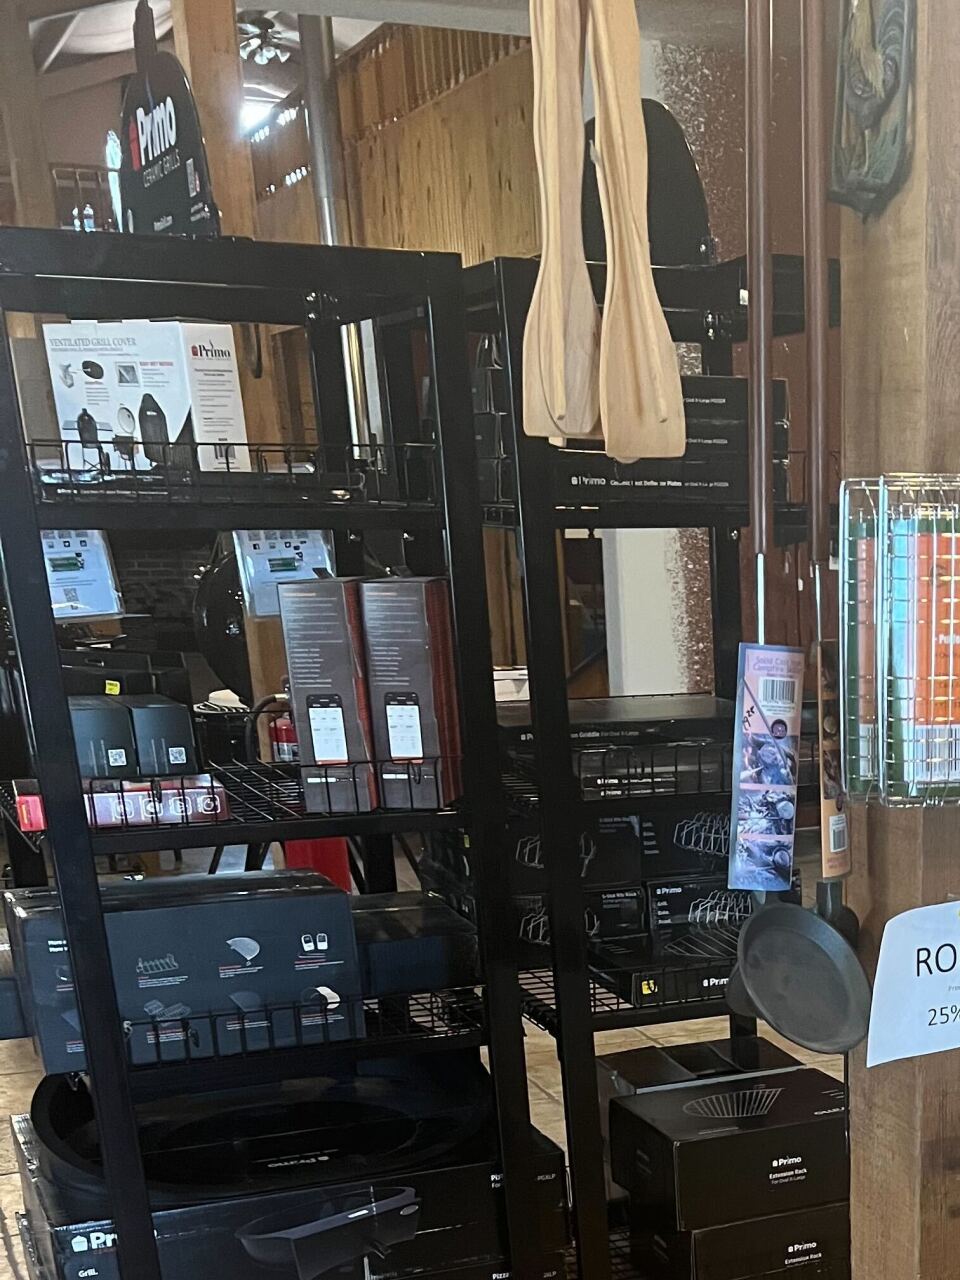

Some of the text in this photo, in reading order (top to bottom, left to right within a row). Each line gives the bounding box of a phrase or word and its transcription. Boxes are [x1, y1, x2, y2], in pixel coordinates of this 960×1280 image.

[136, 96, 177, 166] Primo
[198, 341, 231, 357] Primo
[661, 886, 683, 895] Primo
[778, 1156, 802, 1166] Primo
[769, 1170, 794, 1180] Extension
[90, 1231, 118, 1250] Pr
[794, 1241, 817, 1252] Primo
[78, 1268, 99, 1278] Grill.
